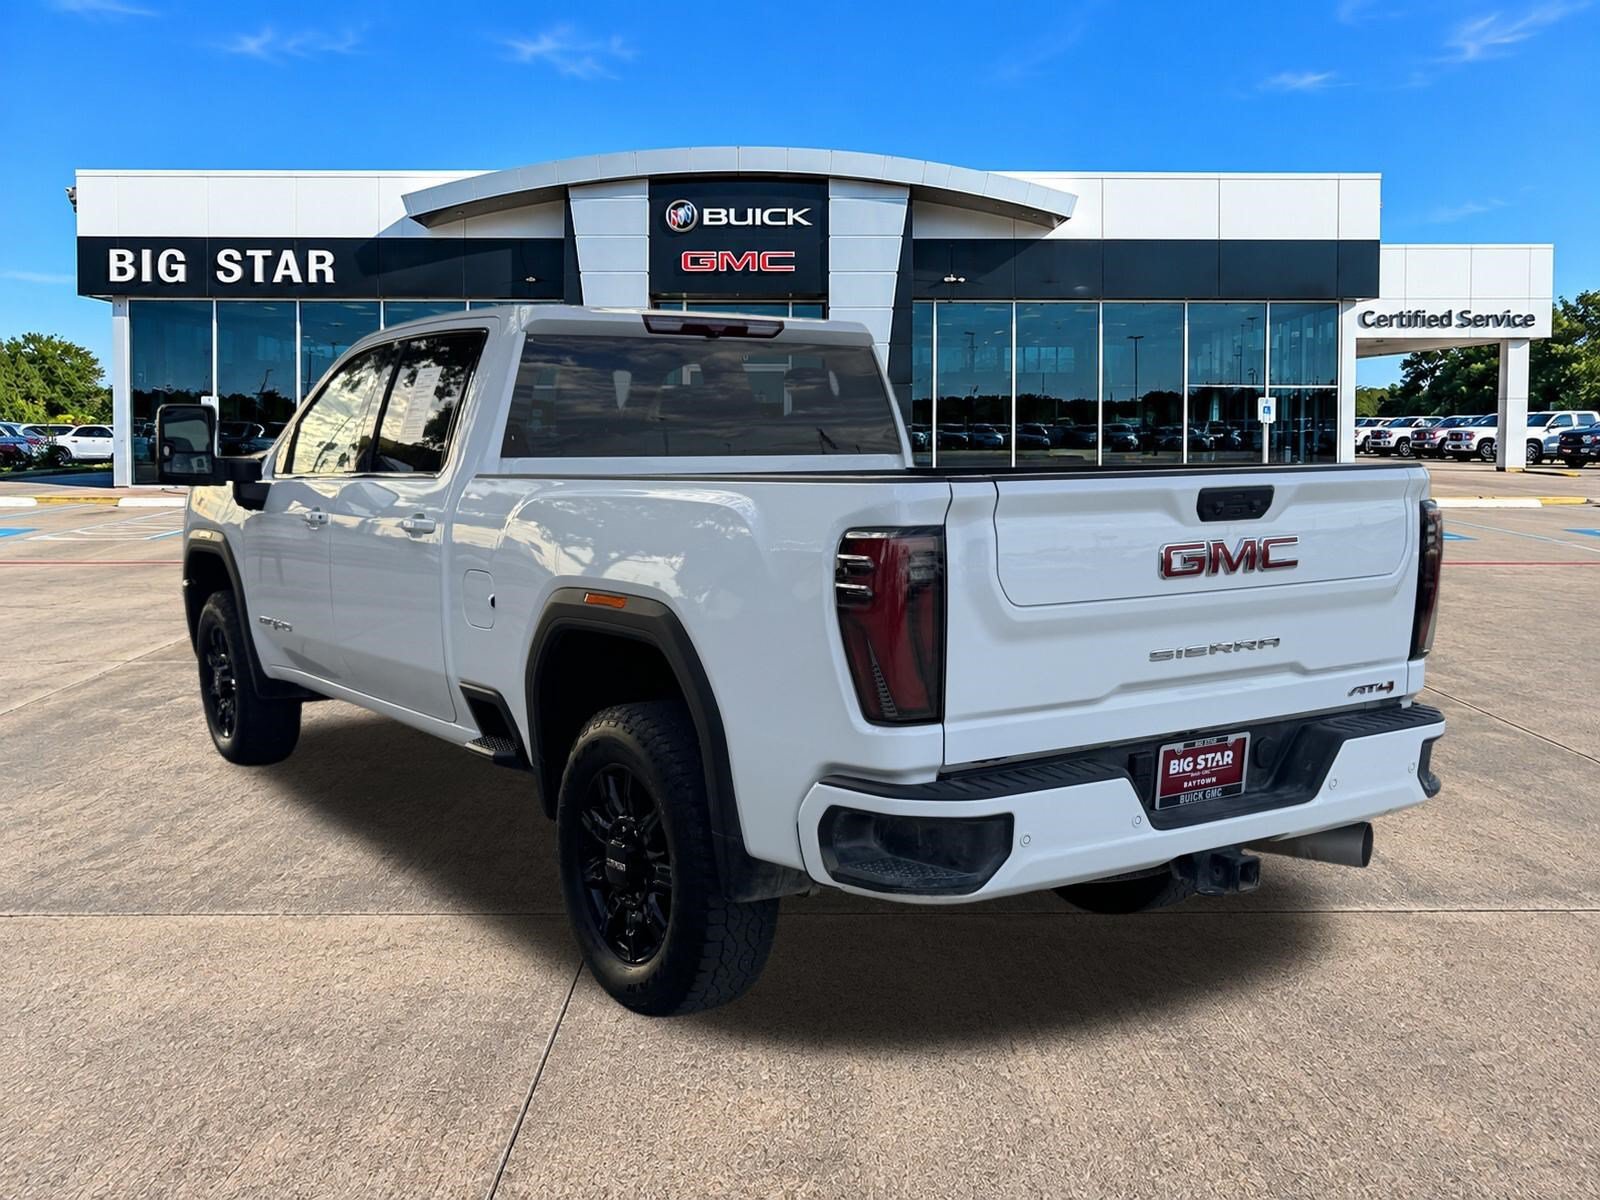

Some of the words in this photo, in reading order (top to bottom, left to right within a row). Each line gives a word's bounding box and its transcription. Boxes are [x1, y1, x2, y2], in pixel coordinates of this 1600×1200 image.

[703, 208, 813, 226] BUICK
[108, 249, 187, 283] BIG
[216, 249, 336, 284] STAR
[681, 250, 796, 272] GMC
[1360, 309, 1453, 329] Certified
[1456, 309, 1536, 329] Service
[1158, 536, 1300, 580] GMC
[1149, 637, 1281, 662] SIERRA
[1347, 680, 1395, 697] AT4
[1169, 757, 1194, 775] BIG
[1196, 750, 1234, 770] STAR
[1183, 777, 1217, 788] BAYTOWN
[1180, 791, 1203, 804] BUICK
[1205, 788, 1223, 798] GMC
